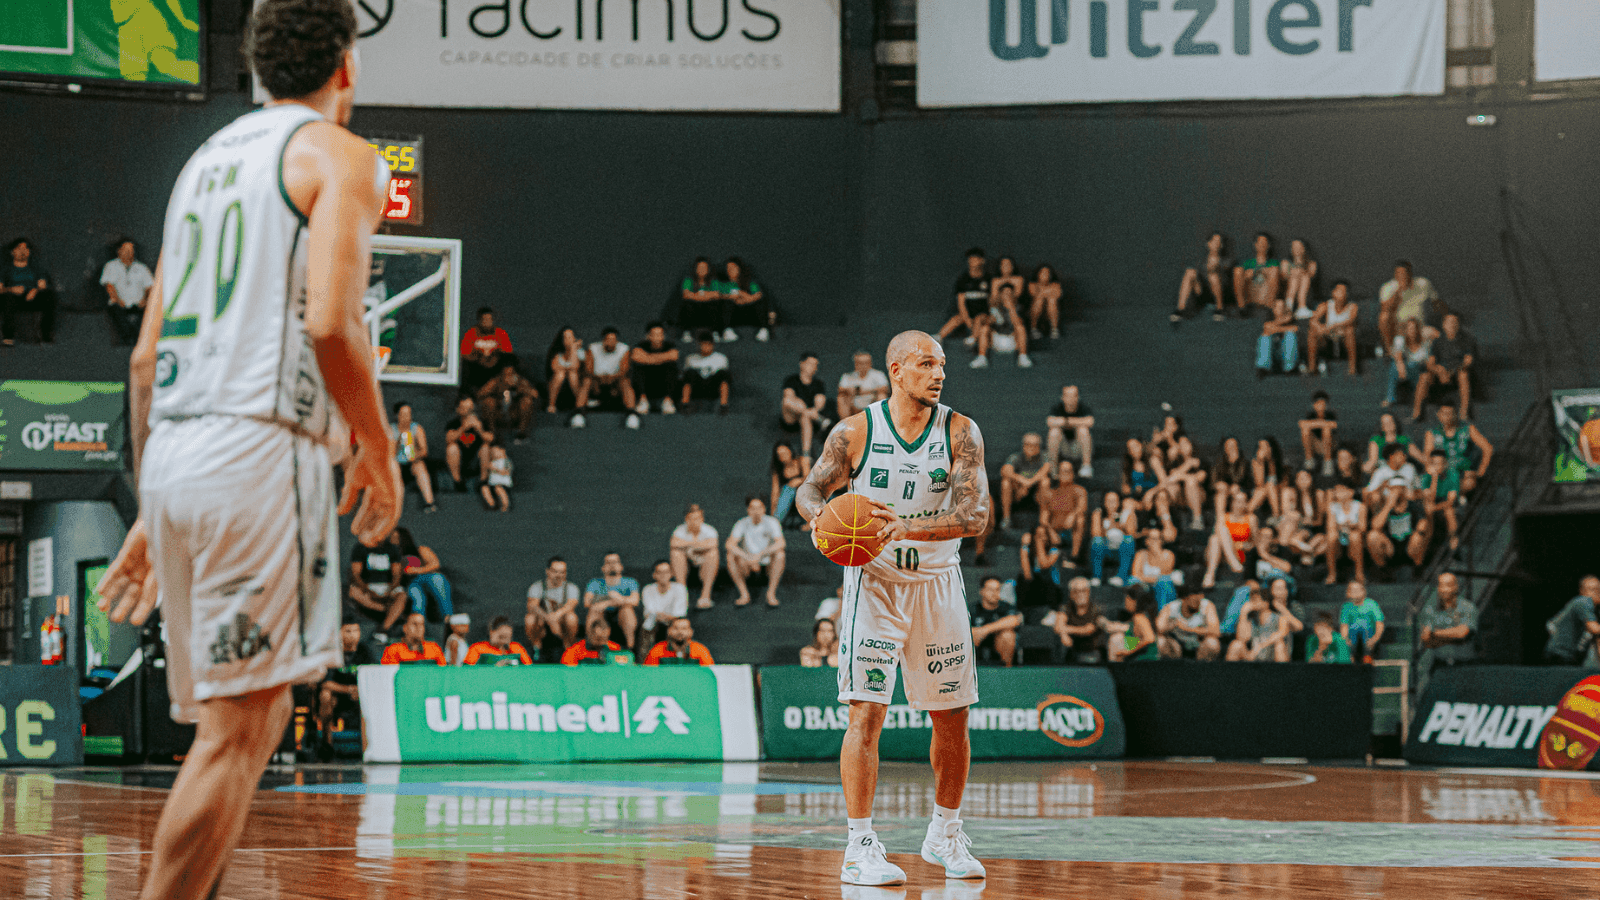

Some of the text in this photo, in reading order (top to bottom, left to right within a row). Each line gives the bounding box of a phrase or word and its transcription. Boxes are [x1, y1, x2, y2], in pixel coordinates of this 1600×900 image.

[439, 50, 569, 67] CAPACIDADE
[576, 53, 602, 68] DE
[611, 53, 671, 68] CRIAR
[158, 200, 243, 341] 20
[53, 422, 109, 442] FAST
[894, 547, 919, 571] 10
[926, 642, 964, 657] Witzler
[944, 655, 965, 668] SPSP
[425, 692, 620, 732] Unimed
[784, 706, 802, 729] O
[803, 705, 924, 730] BASETE
[1418, 701, 1558, 749] PENALTY
